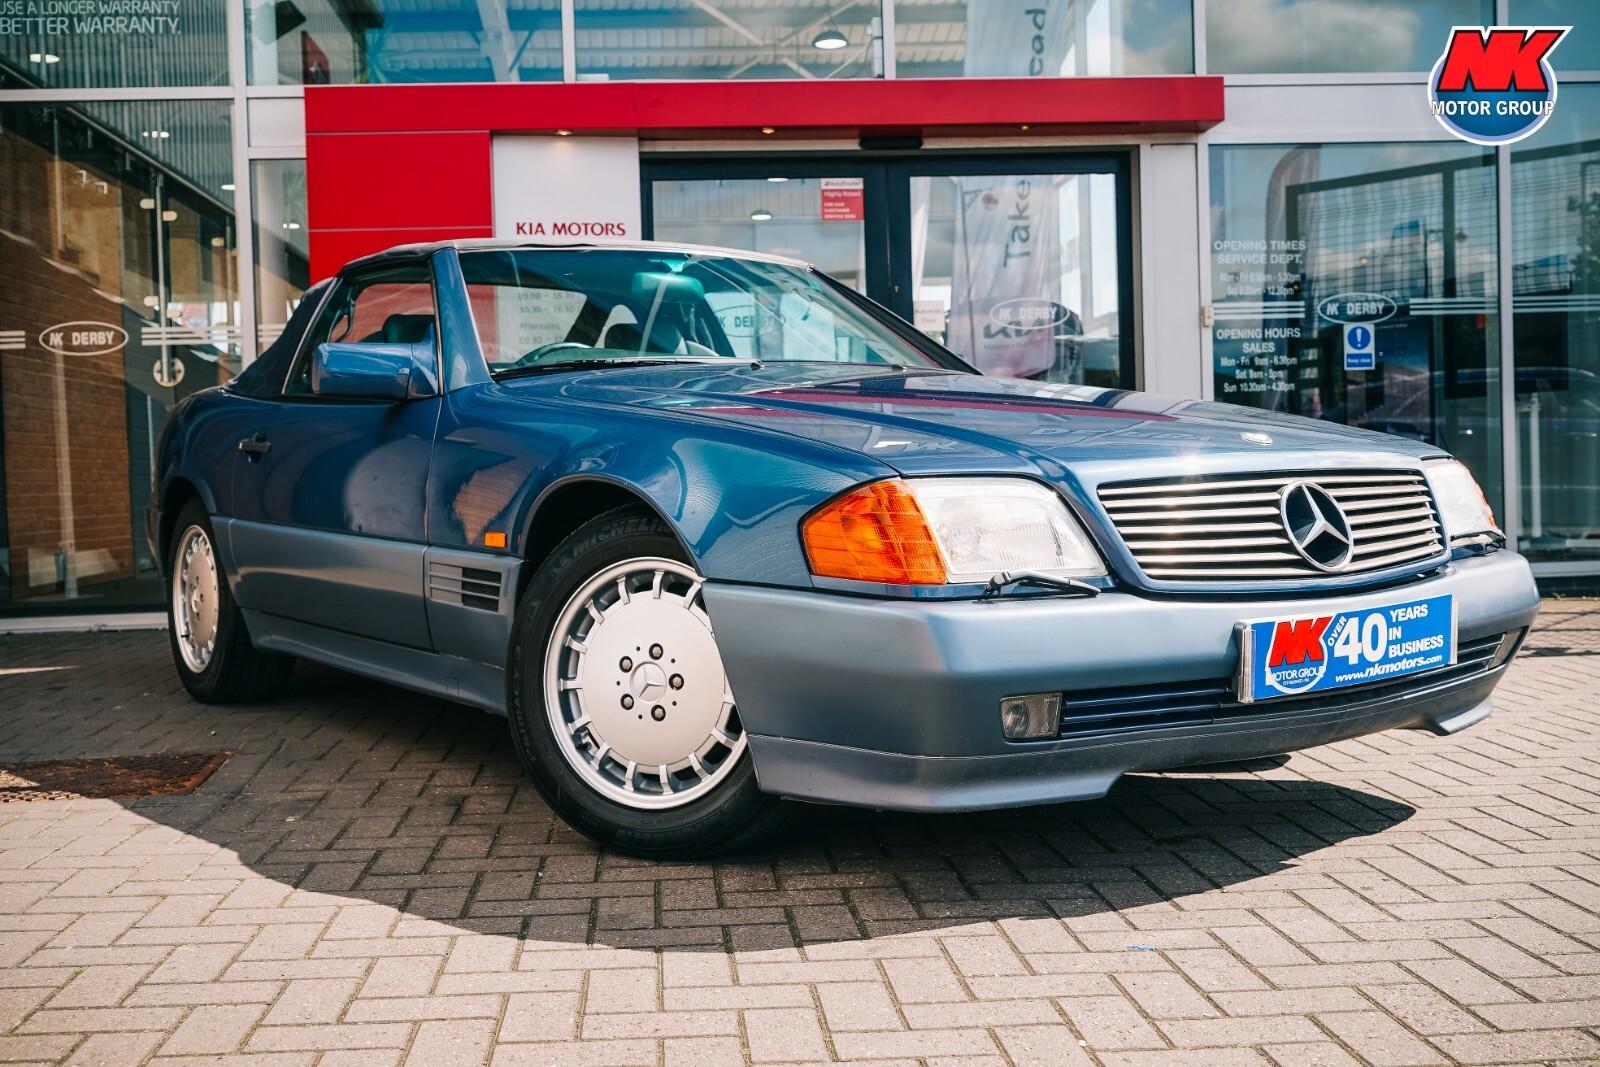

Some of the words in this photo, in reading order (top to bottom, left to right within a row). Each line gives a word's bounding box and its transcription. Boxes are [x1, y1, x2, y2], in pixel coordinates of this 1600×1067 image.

[27, 2, 37, 14] A
[41, 1, 96, 14] LONGER
[99, 1, 180, 14] WARRANTY
[0, 17, 70, 35] BETTER
[74, 17, 181, 35] WARRANTY.
[516, 222, 545, 236] KIA
[552, 222, 625, 236] MOTORS
[1003, 180, 1031, 268] Take
[1214, 240, 1267, 251] OPENING
[1270, 240, 1306, 250] TIMES
[1217, 254, 1267, 264] SERVICE
[1270, 254, 1303, 264] DEPT.
[999, 307, 1012, 320] NK
[1020, 307, 1057, 320] DERBY
[1326, 302, 1339, 315] NK
[1347, 302, 1385, 315] DERBY
[50, 332, 63, 346] NK
[71, 330, 114, 346] DERBY
[1216, 328, 1262, 339] OPENING
[1264, 328, 1301, 338] HOURS
[1242, 342, 1276, 353] SALES
[1221, 357, 1236, 366] Mon
[1241, 356, 1250, 366] Fri
[1254, 356, 1268, 365] 9am
[1235, 369, 1247, 379] Sat
[1248, 370, 1264, 379] 9am
[1224, 382, 1237, 392] Sun
[1390, 604, 1428, 623] YEARS
[1328, 616, 1347, 647] OVER
[1389, 626, 1402, 641] IN
[1269, 616, 1333, 668] NK
[1334, 613, 1387, 665] 40
[1389, 635, 1444, 658] BUSINESS
[1335, 655, 1443, 683] www.nkmotors.com
